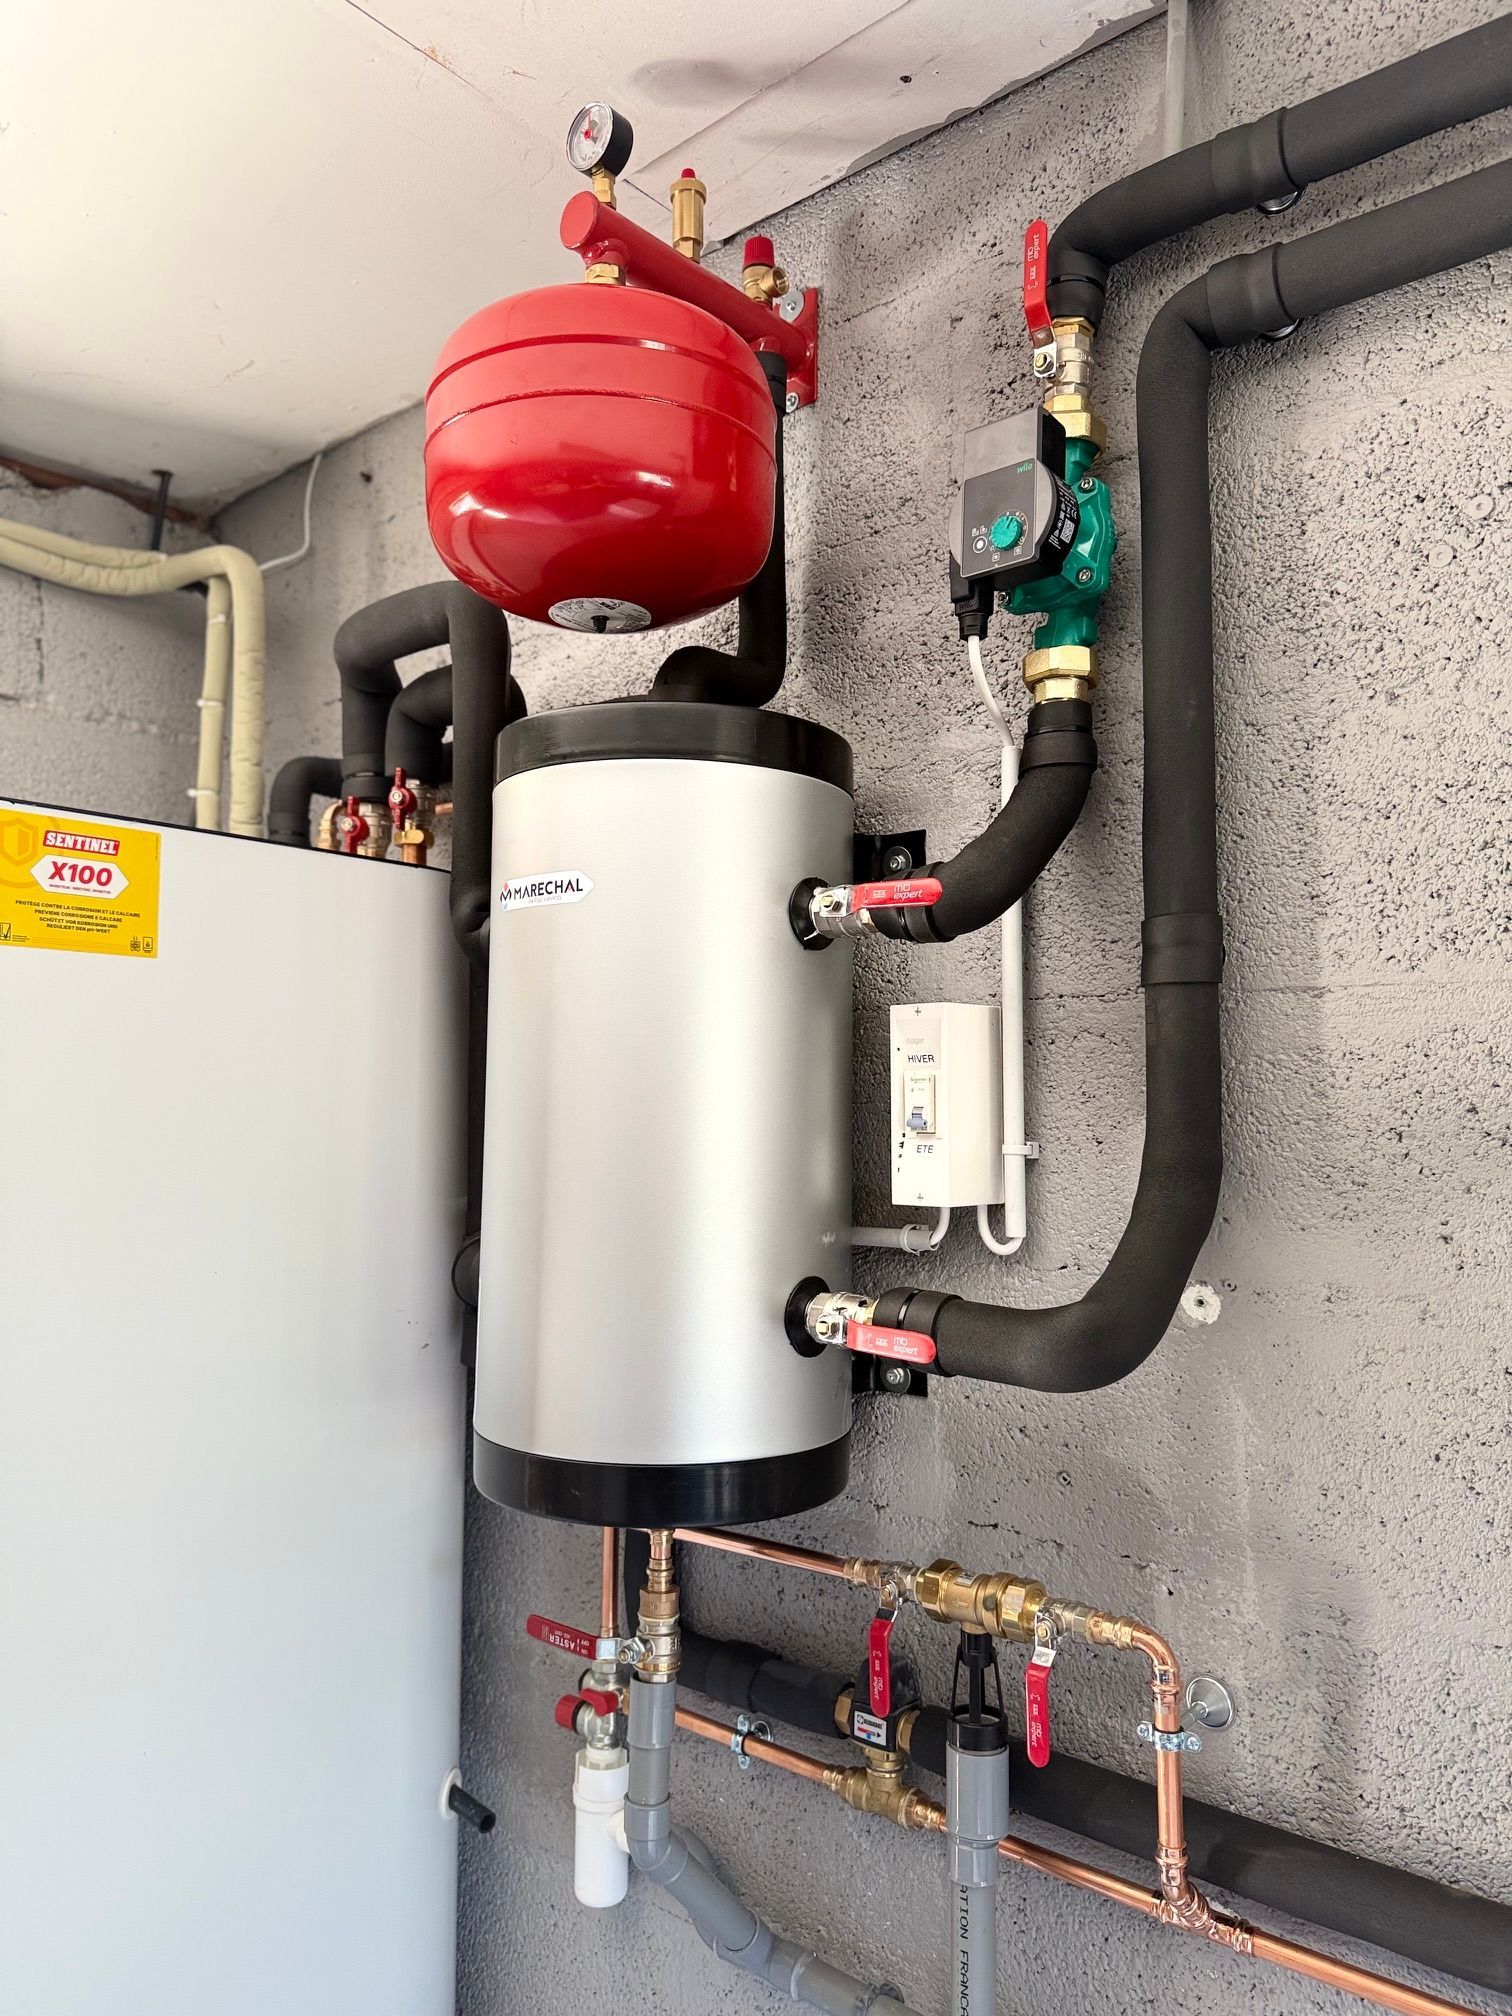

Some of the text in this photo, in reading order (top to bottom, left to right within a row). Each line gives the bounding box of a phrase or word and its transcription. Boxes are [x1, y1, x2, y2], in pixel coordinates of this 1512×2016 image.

[1016, 462, 1033, 474] wilo
[45, 832, 119, 855] SENTINEL
[48, 860, 113, 887] X100
[513, 877, 584, 901] MARECHAL
[893, 888, 924, 900] expert
[41, 902, 63, 910] CONTRE
[70, 905, 101, 914] CORROSION
[907, 1054, 935, 1063] HIVER
[916, 1144, 934, 1154] ETE
[893, 1344, 919, 1356] expert
[549, 1633, 576, 1650] ASTER
[872, 1675, 880, 1700] expert
[1030, 1721, 1038, 1748] expert
